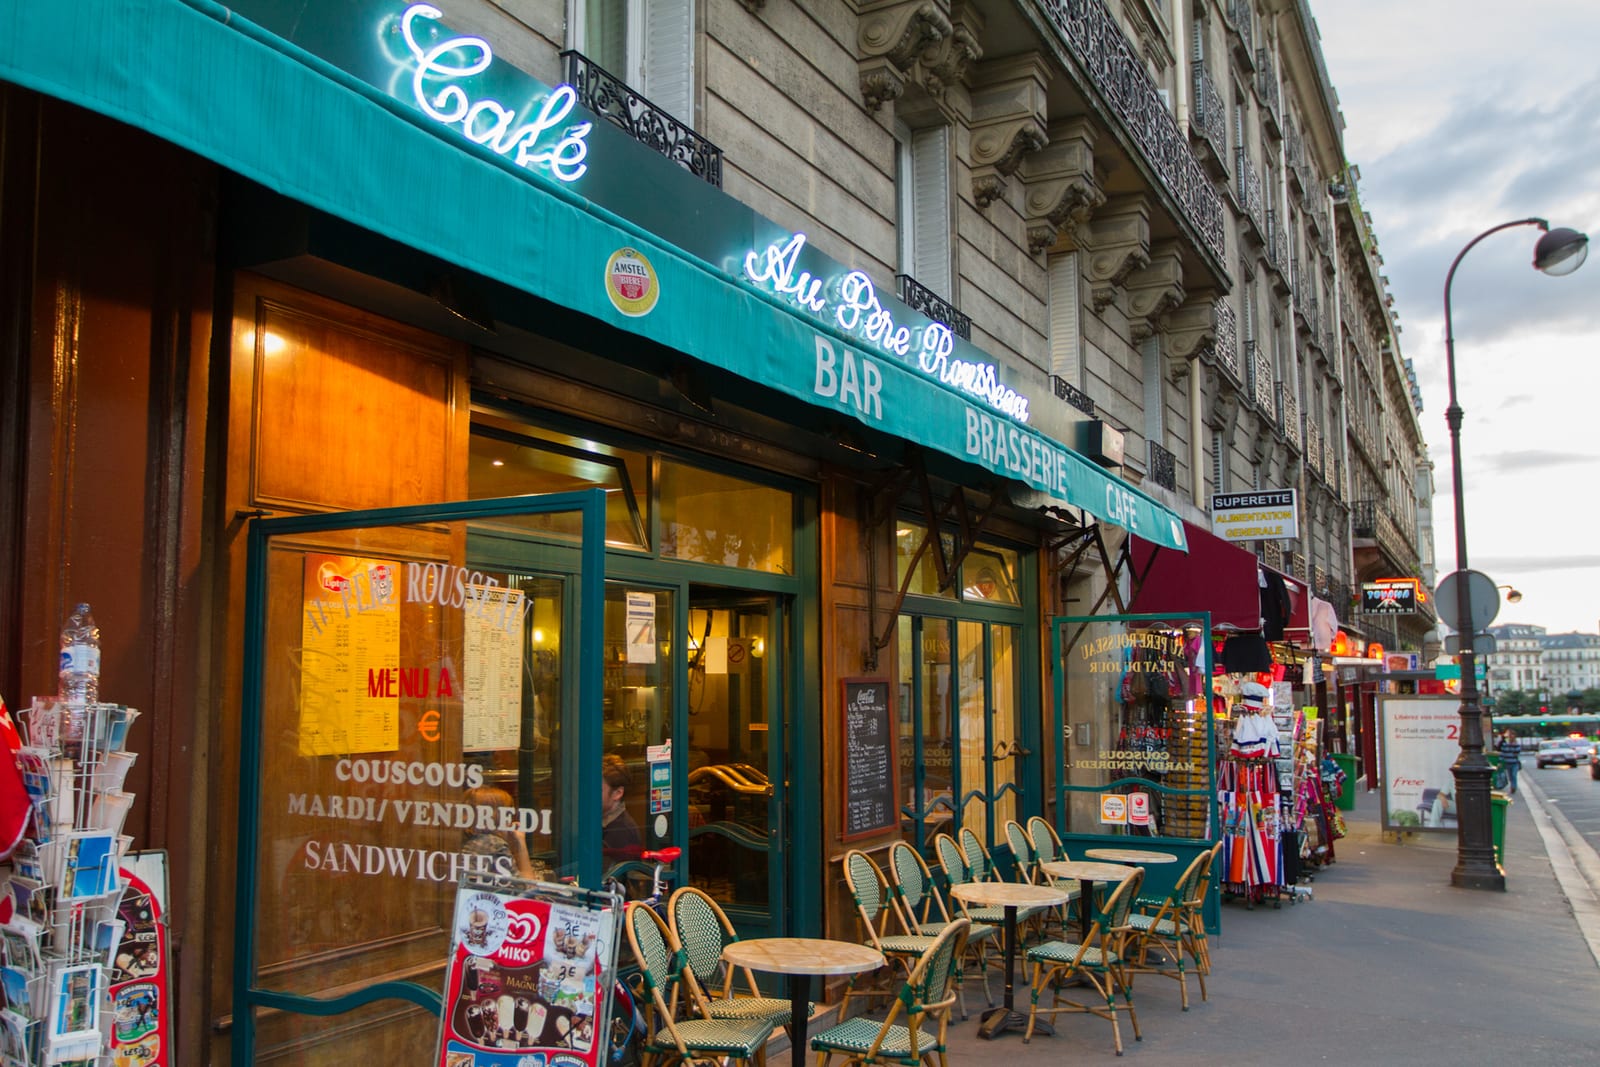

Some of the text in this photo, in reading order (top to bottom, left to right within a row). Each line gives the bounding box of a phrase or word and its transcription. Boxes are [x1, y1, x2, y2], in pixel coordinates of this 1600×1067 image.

[402, 4, 592, 182] Café
[614, 262, 647, 276] AMSTEL
[745, 233, 826, 312] Au
[919, 322, 1029, 423] Rousseau
[814, 335, 882, 420] BAR
[965, 407, 1068, 494] BRASSERIE
[1106, 483, 1137, 529] CAFE
[1215, 493, 1291, 508] SUPERETTE
[1216, 511, 1292, 523] ALIMENTATION
[1225, 525, 1283, 538] GENERALE
[406, 562, 534, 636] ROUSSEAU
[367, 667, 453, 699] MENU A
[418, 710, 441, 742] €
[335, 759, 484, 788] COUSCOUS
[1393, 776, 1424, 788] free
[304, 840, 514, 887] SANDWICHES
[498, 945, 531, 962] MIKO
[506, 976, 539, 991] MAGNU
